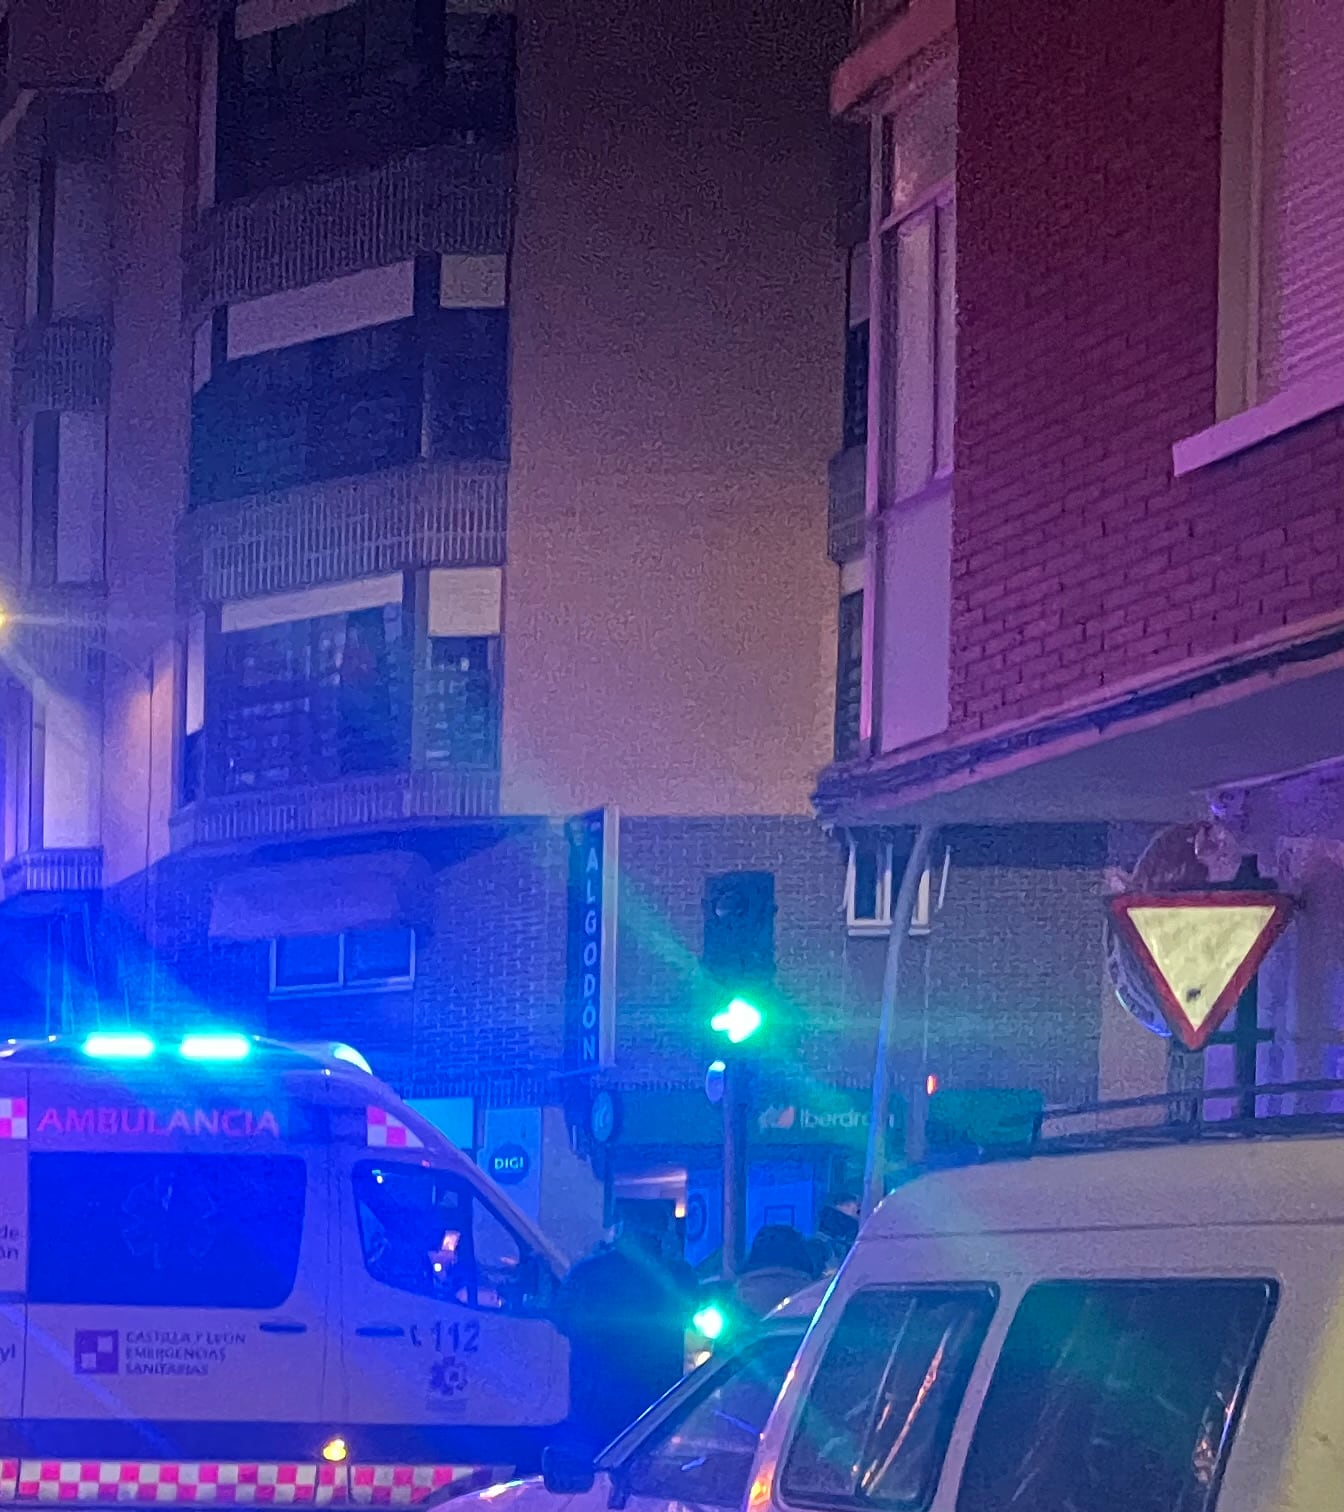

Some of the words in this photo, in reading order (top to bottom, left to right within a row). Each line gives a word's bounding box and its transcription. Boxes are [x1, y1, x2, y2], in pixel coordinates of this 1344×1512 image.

[36, 1107, 280, 1137] AMBULANCIA
[494, 1156, 524, 1170] DIGI
[431, 1319, 481, 1353] 112
